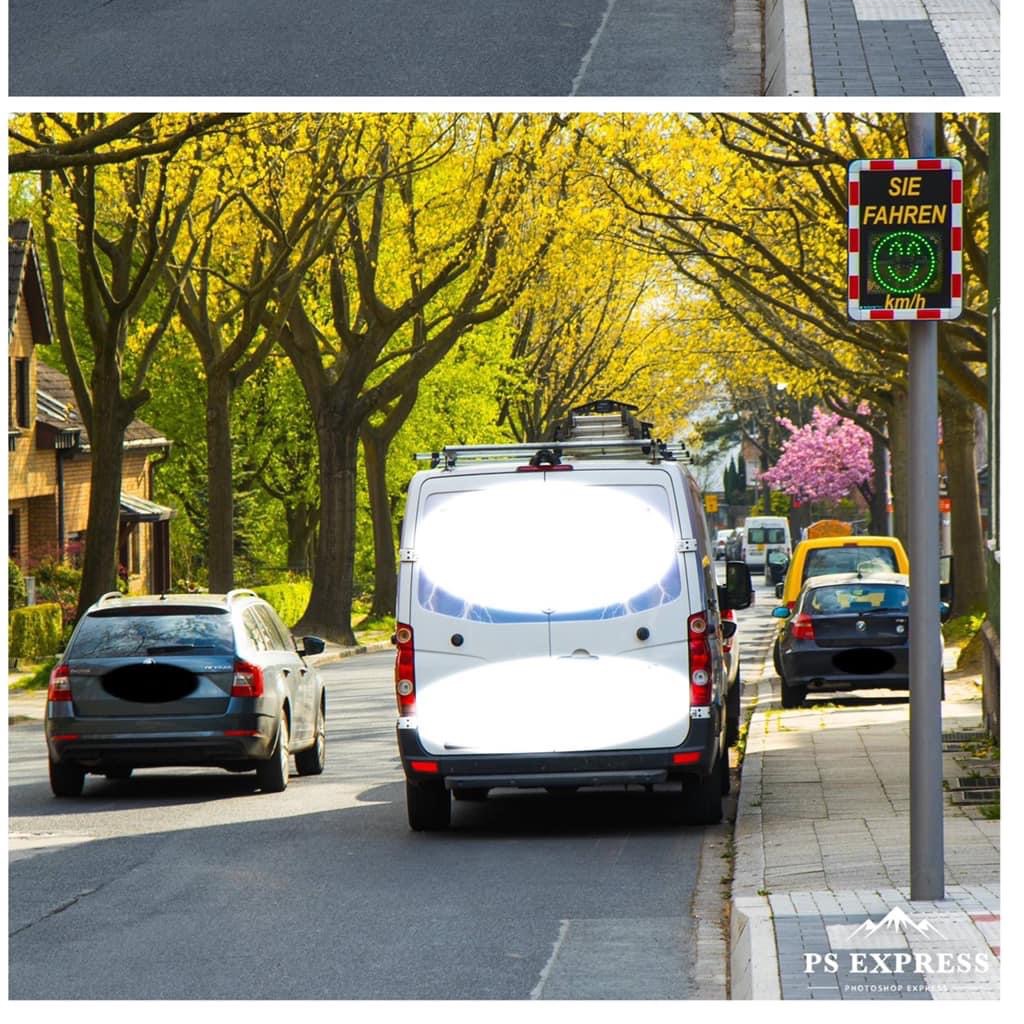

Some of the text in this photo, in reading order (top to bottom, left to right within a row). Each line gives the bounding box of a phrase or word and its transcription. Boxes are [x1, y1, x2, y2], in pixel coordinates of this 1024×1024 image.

[888, 176, 922, 197] SIE
[863, 205, 947, 225] FAHREN
[884, 293, 926, 309] km/h
